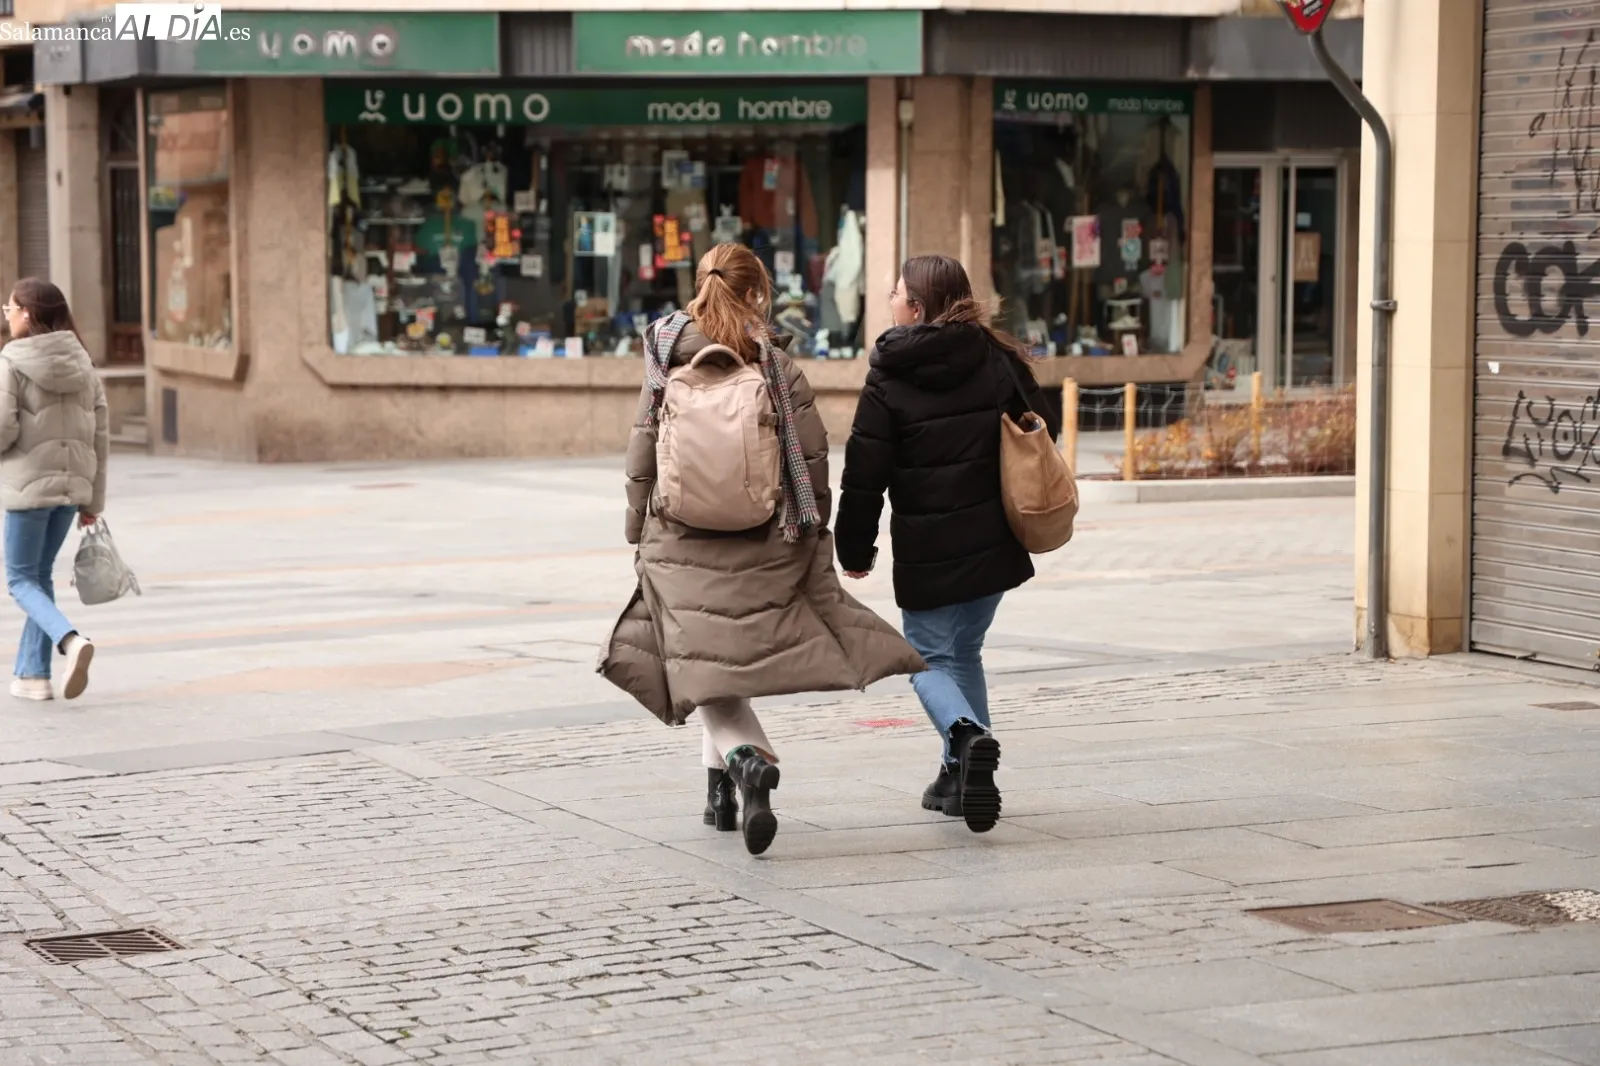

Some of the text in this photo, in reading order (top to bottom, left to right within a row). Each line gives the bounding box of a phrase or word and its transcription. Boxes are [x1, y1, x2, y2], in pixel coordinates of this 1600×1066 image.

[626, 30, 868, 58] moda hombre
[647, 98, 833, 121] moda hombre
[1107, 97, 1142, 112] moda
[1143, 97, 1185, 113] hombre
